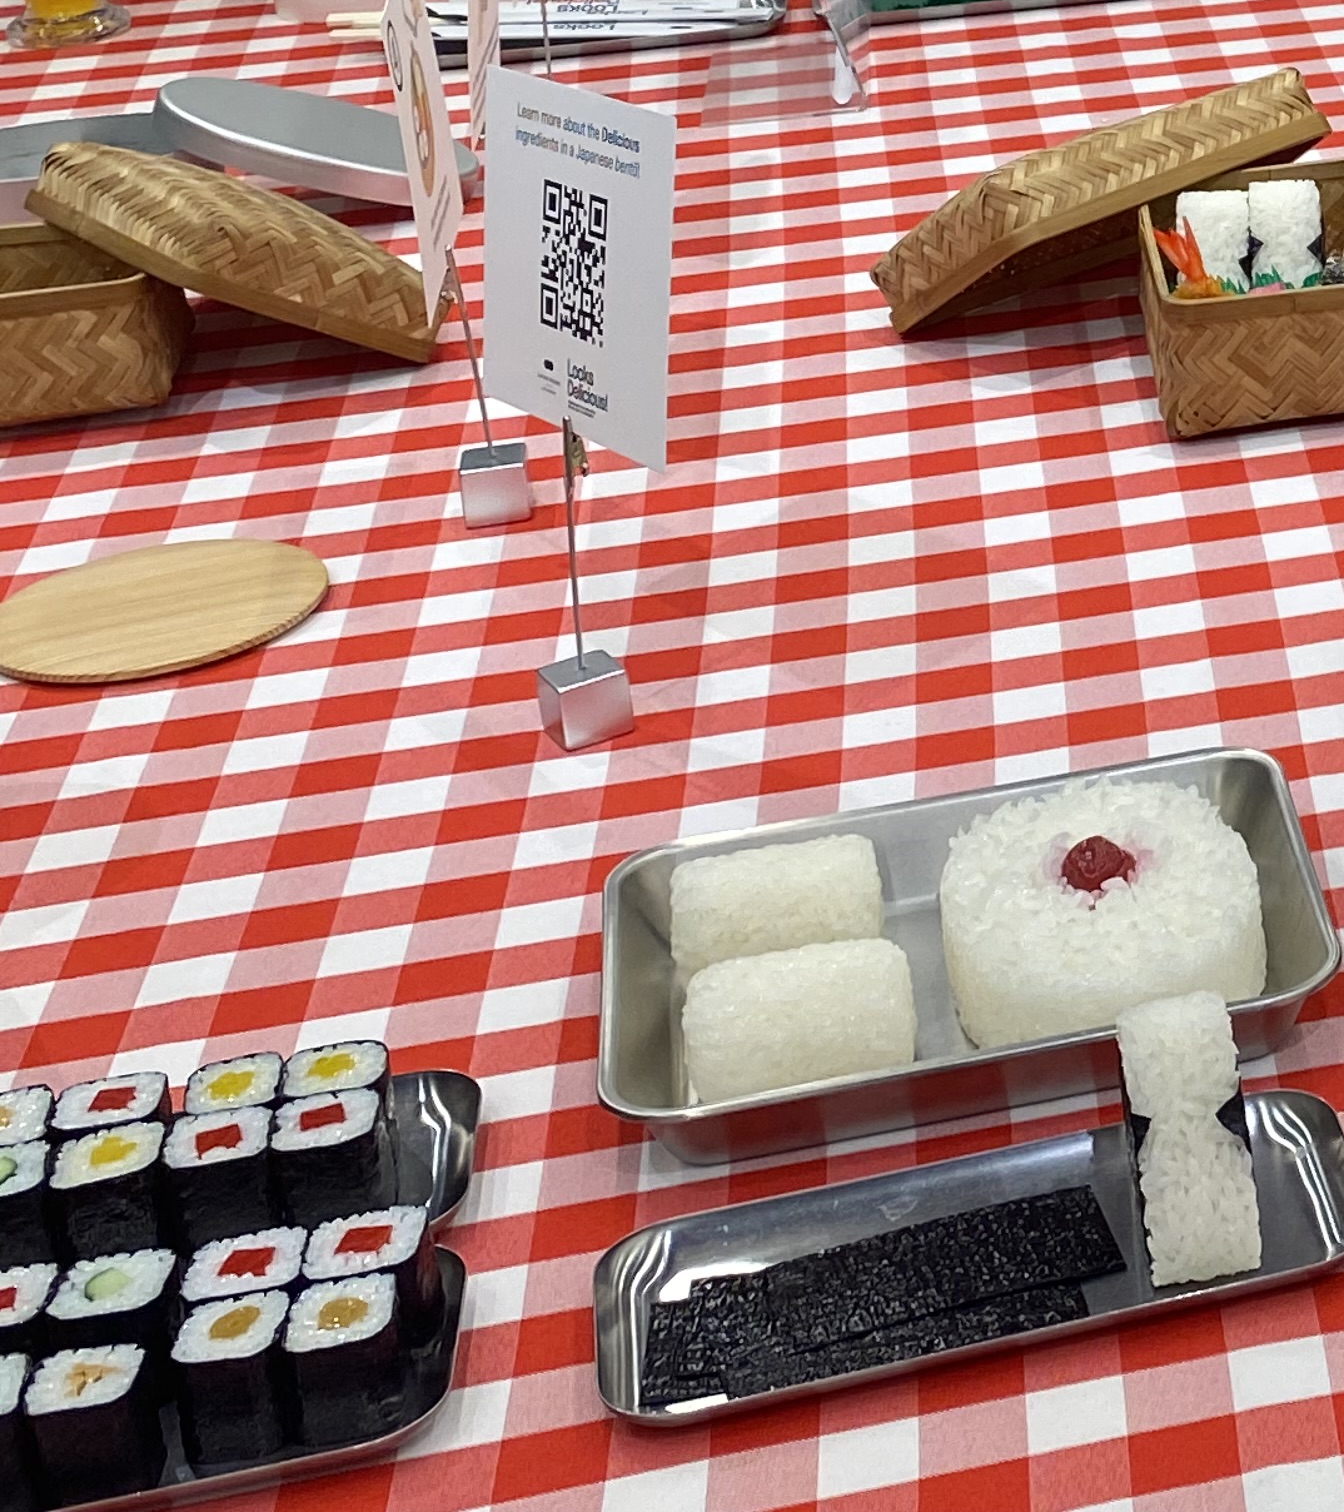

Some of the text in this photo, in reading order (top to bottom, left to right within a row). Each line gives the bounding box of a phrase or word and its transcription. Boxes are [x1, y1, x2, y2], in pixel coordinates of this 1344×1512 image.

[517, 102, 640, 153] Learn more about the Delicious
[516, 125, 559, 150] ingredients
[560, 140, 568, 154] in
[576, 144, 613, 169] Japanese
[567, 358, 594, 386] Looks
[567, 379, 608, 412] Delicious!
